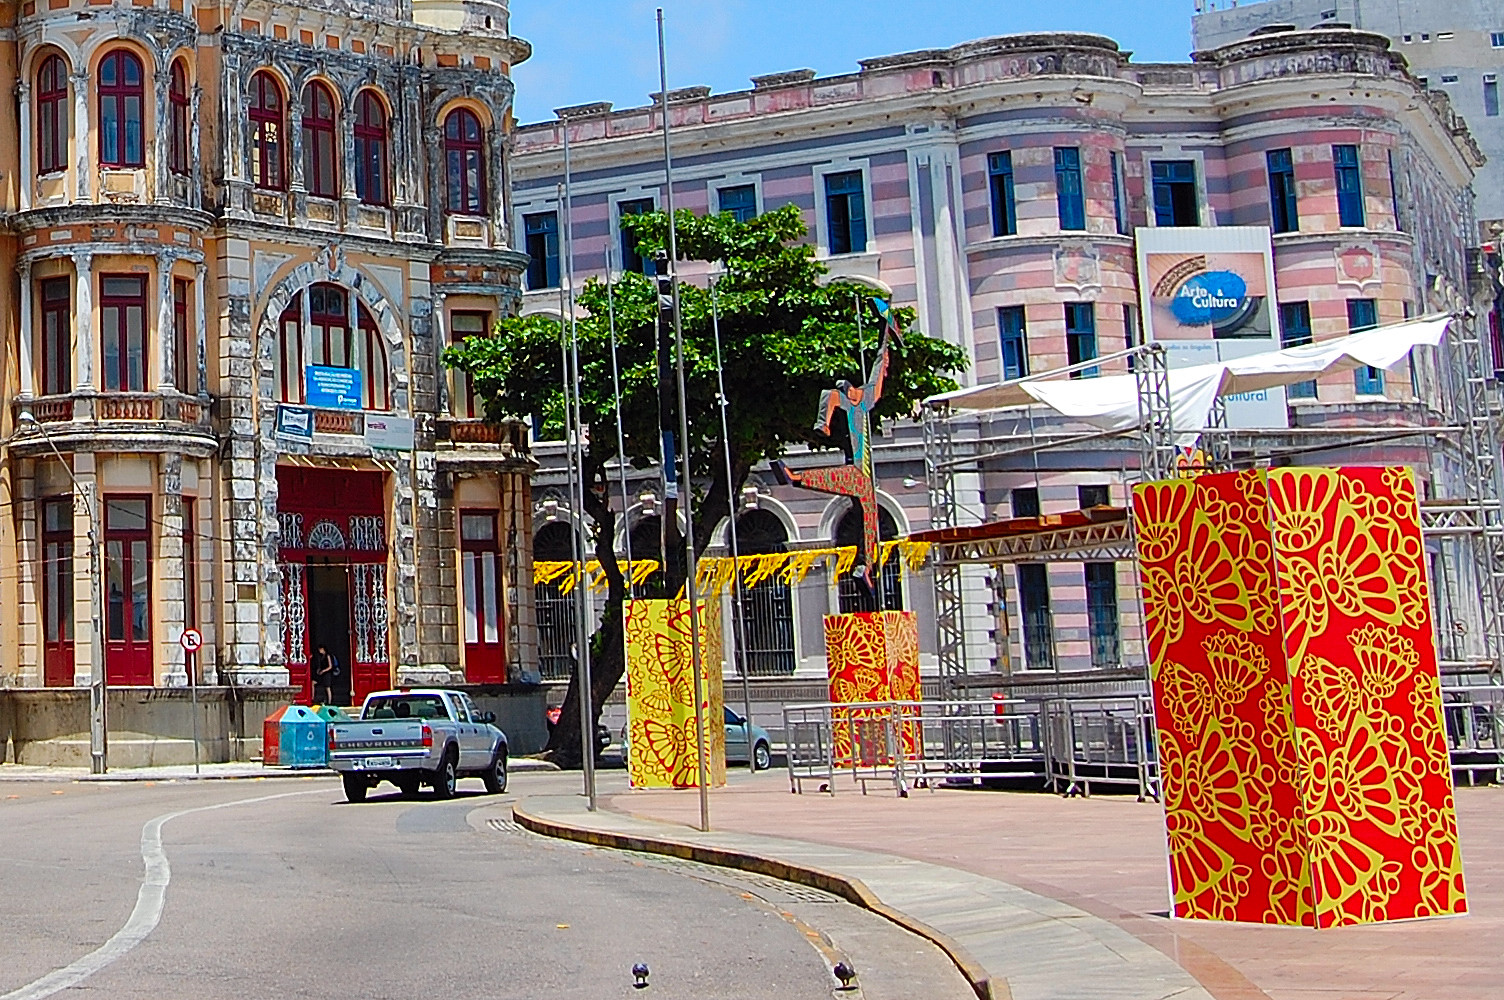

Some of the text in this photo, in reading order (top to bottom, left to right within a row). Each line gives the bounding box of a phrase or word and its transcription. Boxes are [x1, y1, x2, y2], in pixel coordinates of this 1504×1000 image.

[1181, 285, 1224, 297] Arte &
[1192, 294, 1238, 308] Cultura
